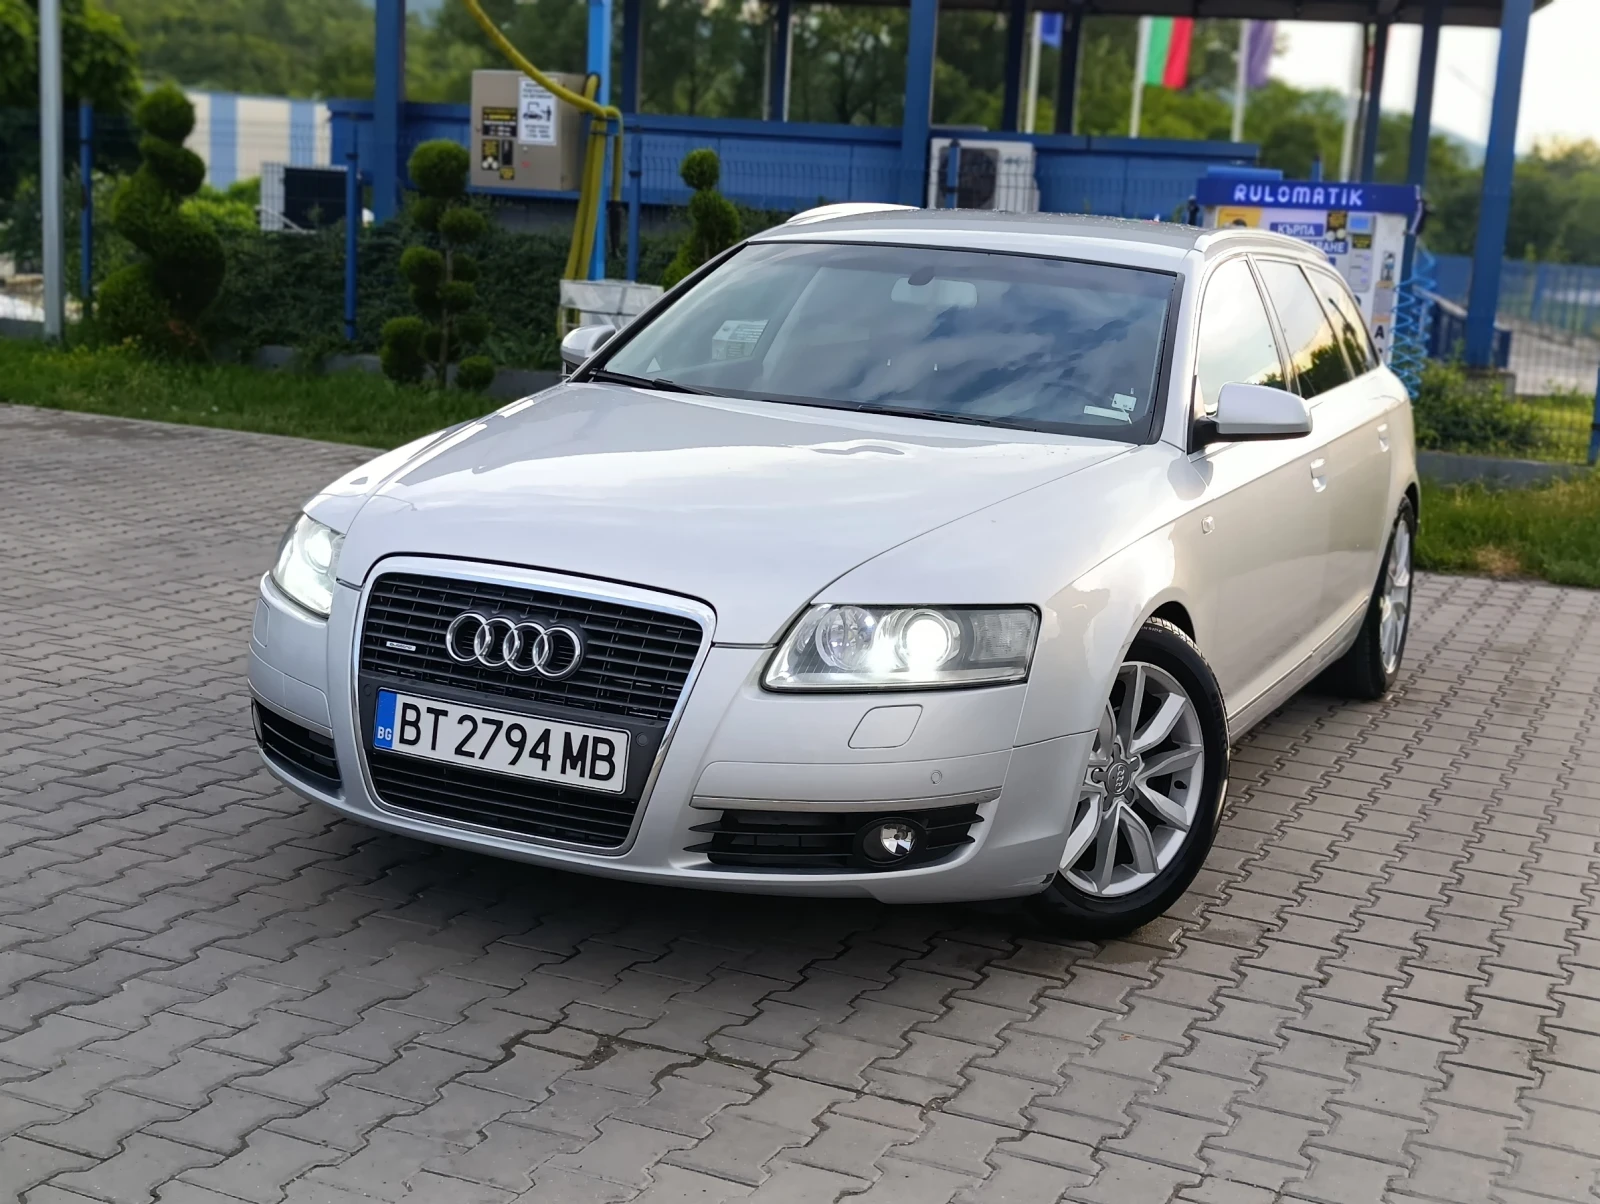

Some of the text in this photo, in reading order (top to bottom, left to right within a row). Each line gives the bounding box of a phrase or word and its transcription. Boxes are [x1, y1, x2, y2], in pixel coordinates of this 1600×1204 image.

[1234, 184, 1363, 206] RULOMATIK
[1278, 223, 1315, 236] КЪРПА
[377, 726, 392, 741] BG
[398, 702, 616, 782] BT 2794 MB
